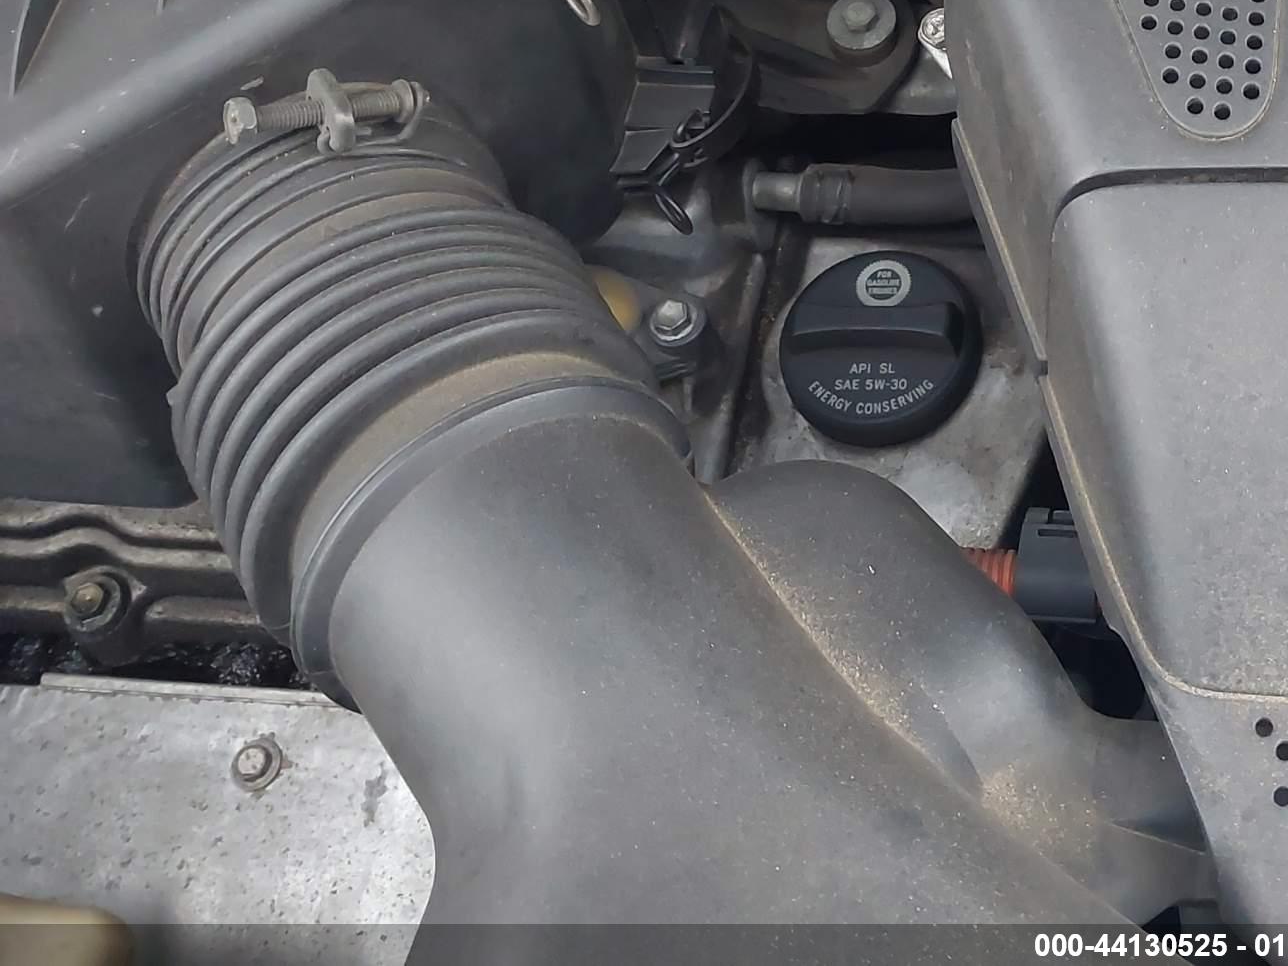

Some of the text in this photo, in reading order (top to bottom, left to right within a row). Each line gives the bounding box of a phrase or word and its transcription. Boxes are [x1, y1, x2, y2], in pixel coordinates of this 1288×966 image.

[849, 362, 896, 374] API SL
[834, 378, 908, 391] SAE 5W-30
[807, 379, 935, 415] ENERGY CONSERVING
